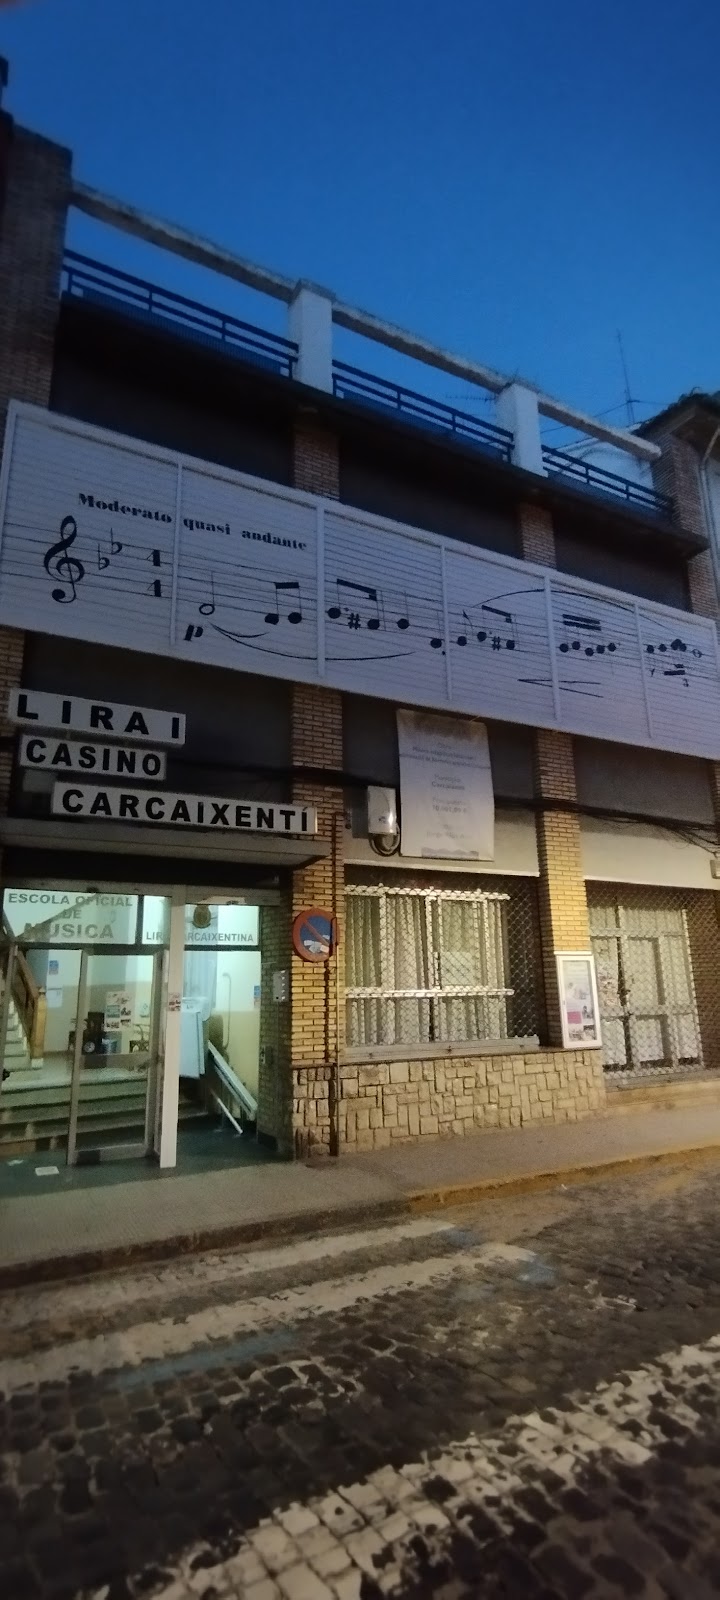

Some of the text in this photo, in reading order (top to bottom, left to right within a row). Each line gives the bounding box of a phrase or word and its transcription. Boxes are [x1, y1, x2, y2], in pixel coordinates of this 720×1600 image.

[78, 492, 307, 550] Moderato quasi andante
[17, 694, 179, 738] LIRA I
[26, 739, 161, 775] CASINO
[62, 789, 309, 832] CARCAIXENTÍ
[8, 893, 133, 907] ESCOLA OFICIAL
[61, 909, 82, 919] DE
[146, 931, 254, 942] LIR RCAIXENTINA
